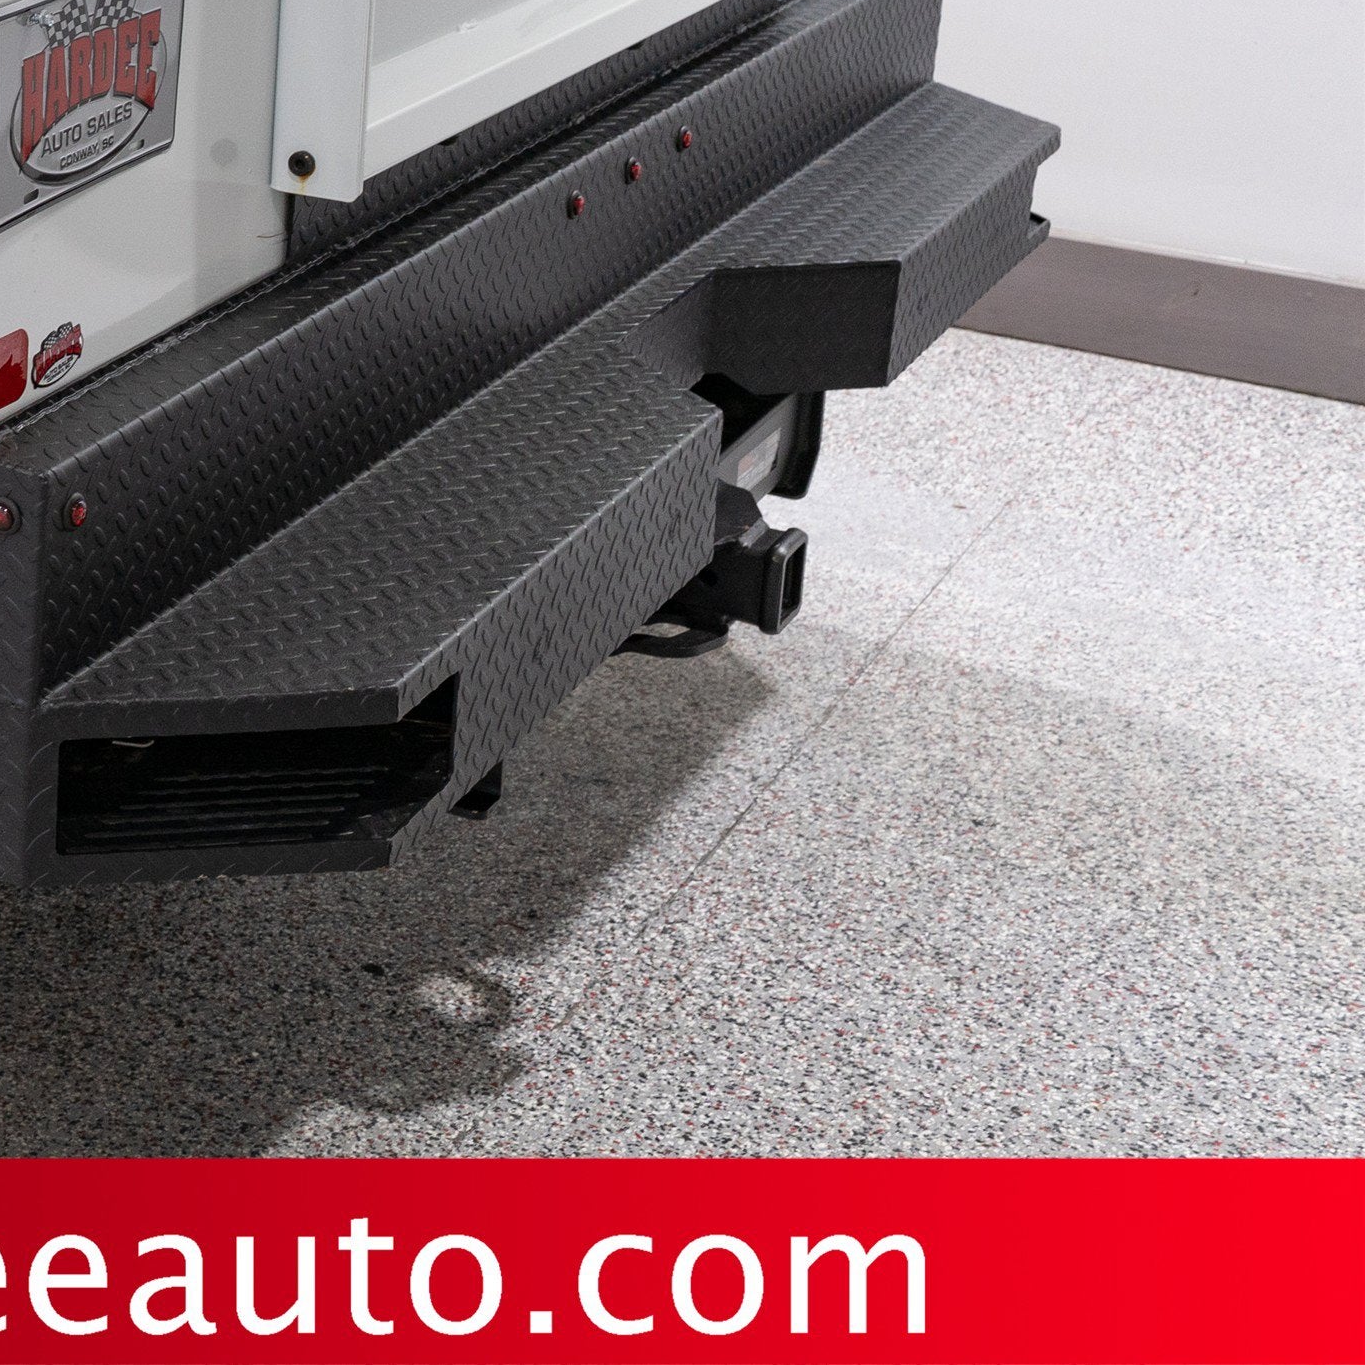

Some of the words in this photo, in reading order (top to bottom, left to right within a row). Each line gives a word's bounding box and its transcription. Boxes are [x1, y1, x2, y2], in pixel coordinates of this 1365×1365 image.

[19, 8, 162, 166] HARDEE
[41, 122, 82, 158] AUTO
[87, 101, 133, 139] SALES
[59, 143, 100, 169] CONWAY,
[102, 135, 115, 153] SC
